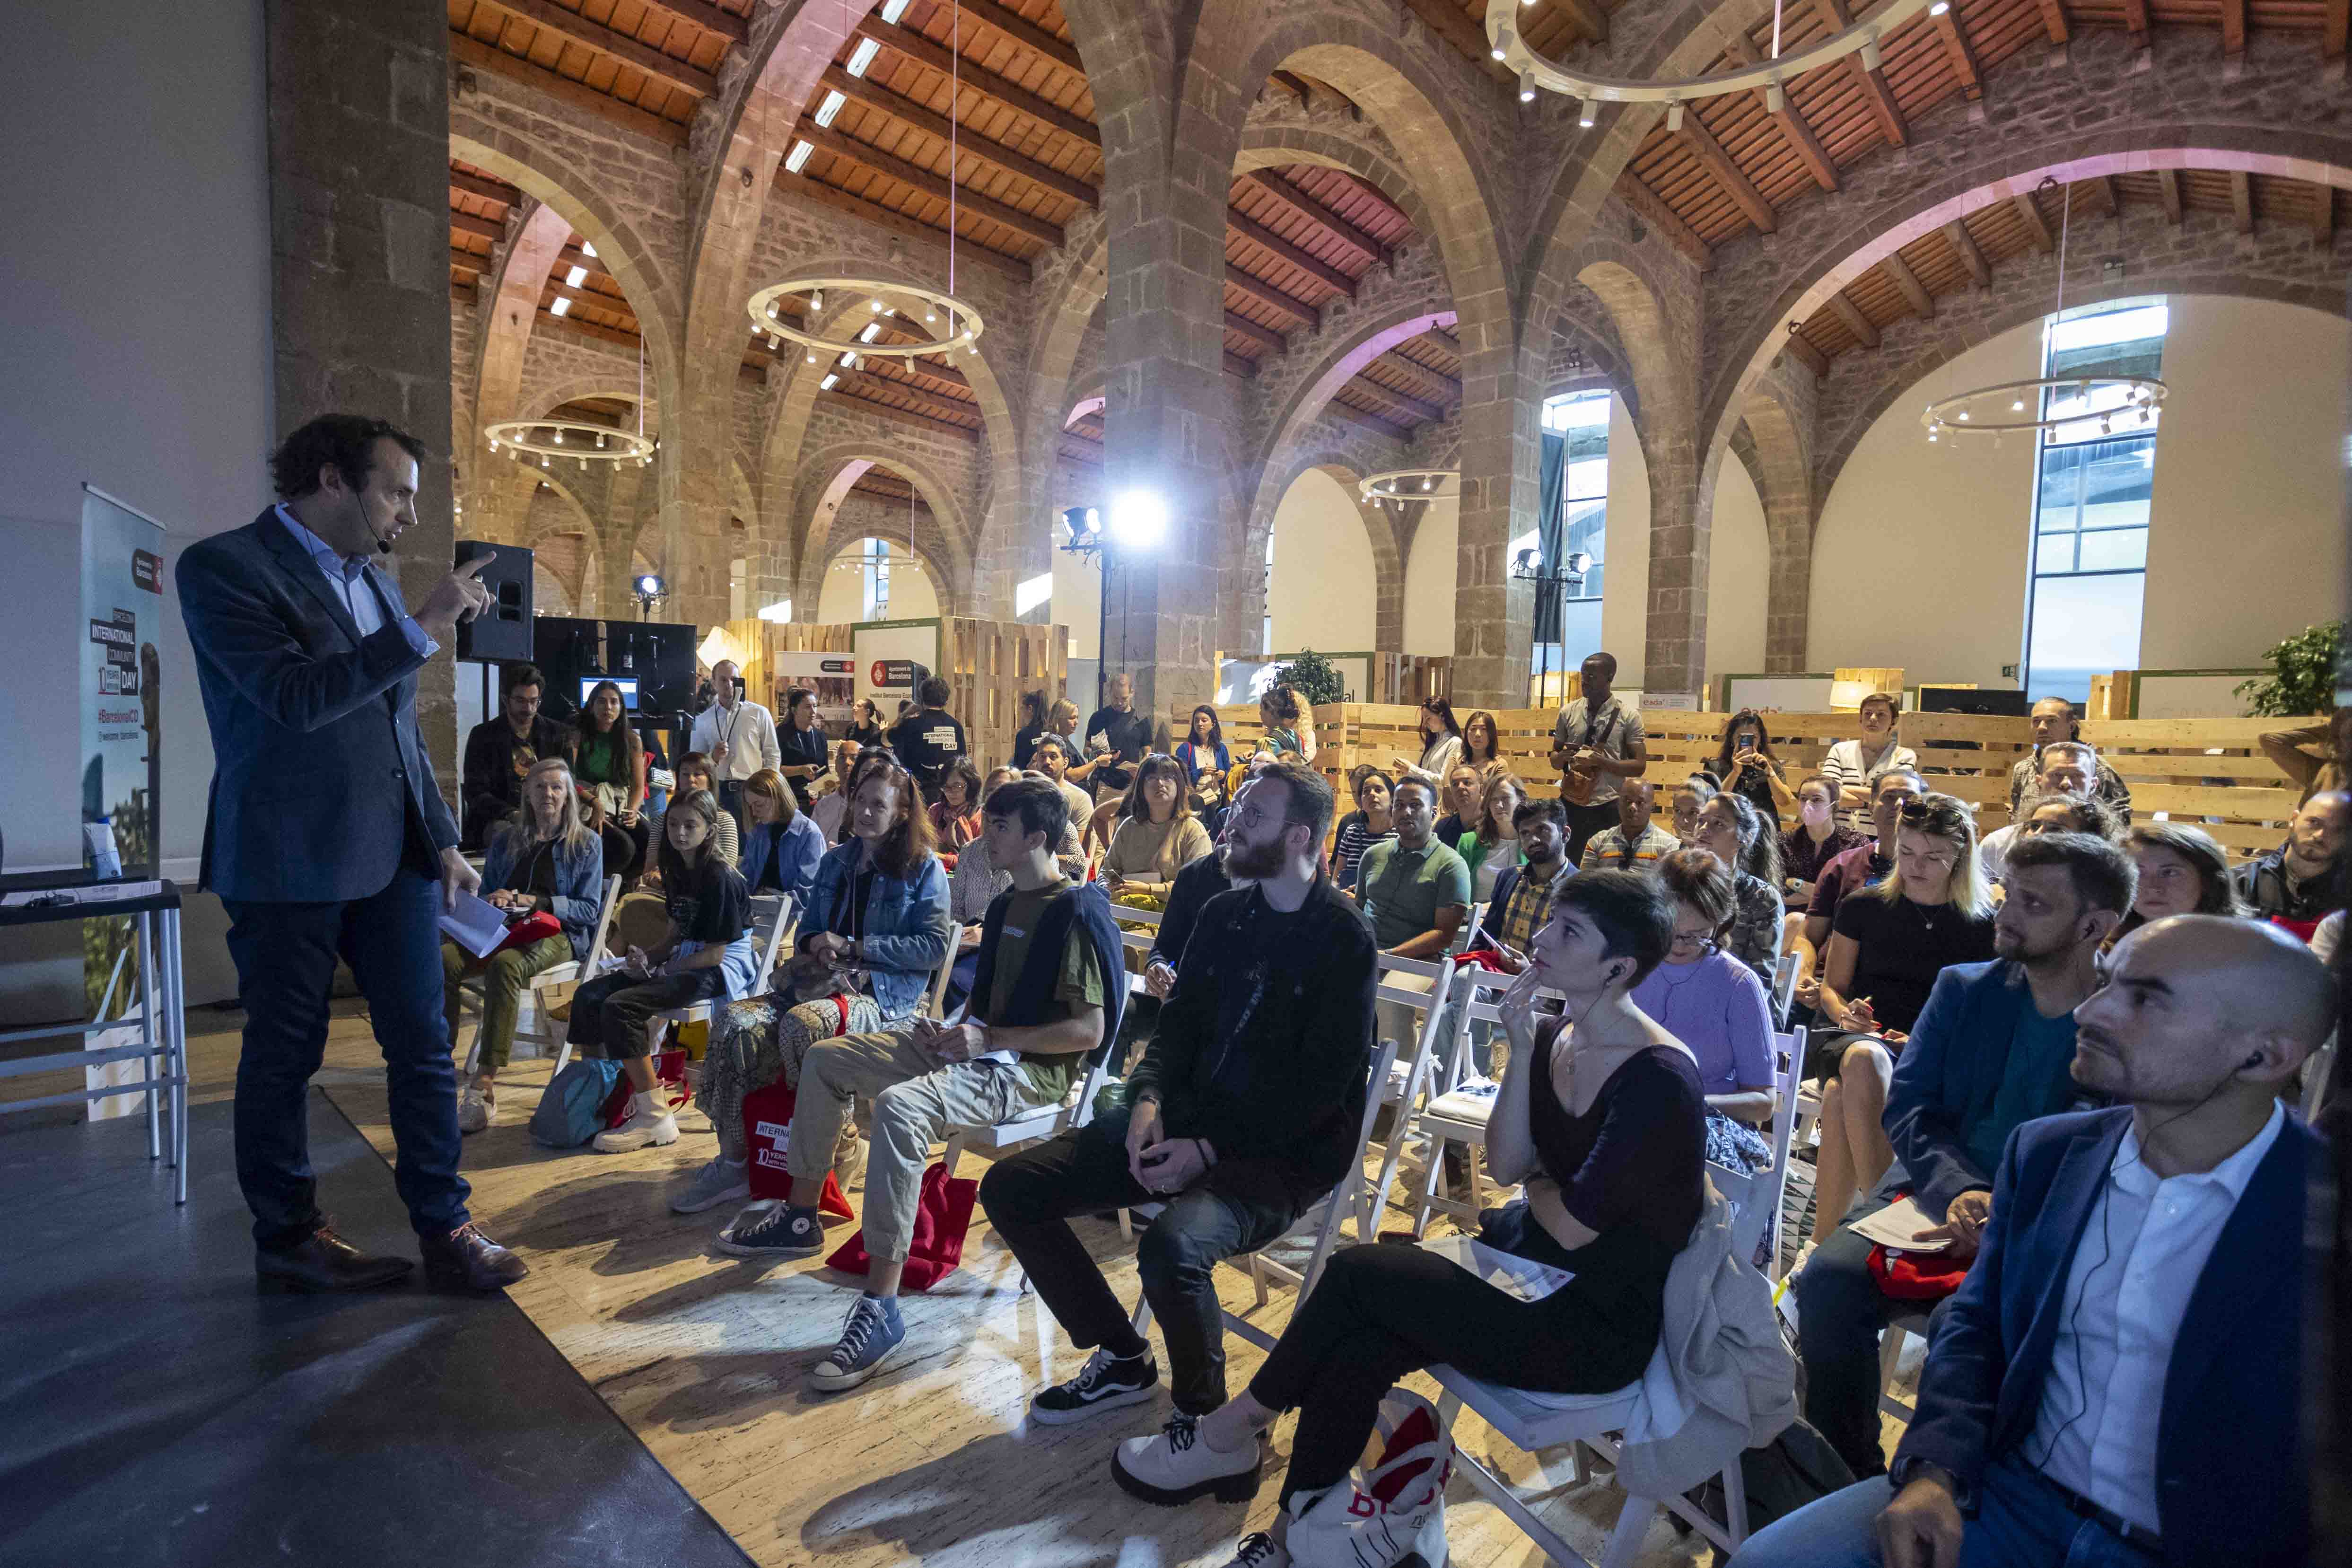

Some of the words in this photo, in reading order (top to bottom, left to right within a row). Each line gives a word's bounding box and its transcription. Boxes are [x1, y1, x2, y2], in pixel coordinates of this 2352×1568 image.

[92, 624, 134, 644] INTERNATIONAL
[108, 648, 135, 662] COMMUNITY
[121, 671, 137, 689] DAY
[758, 1148, 769, 1164] 10
[770, 1152, 787, 1161] YEAR
